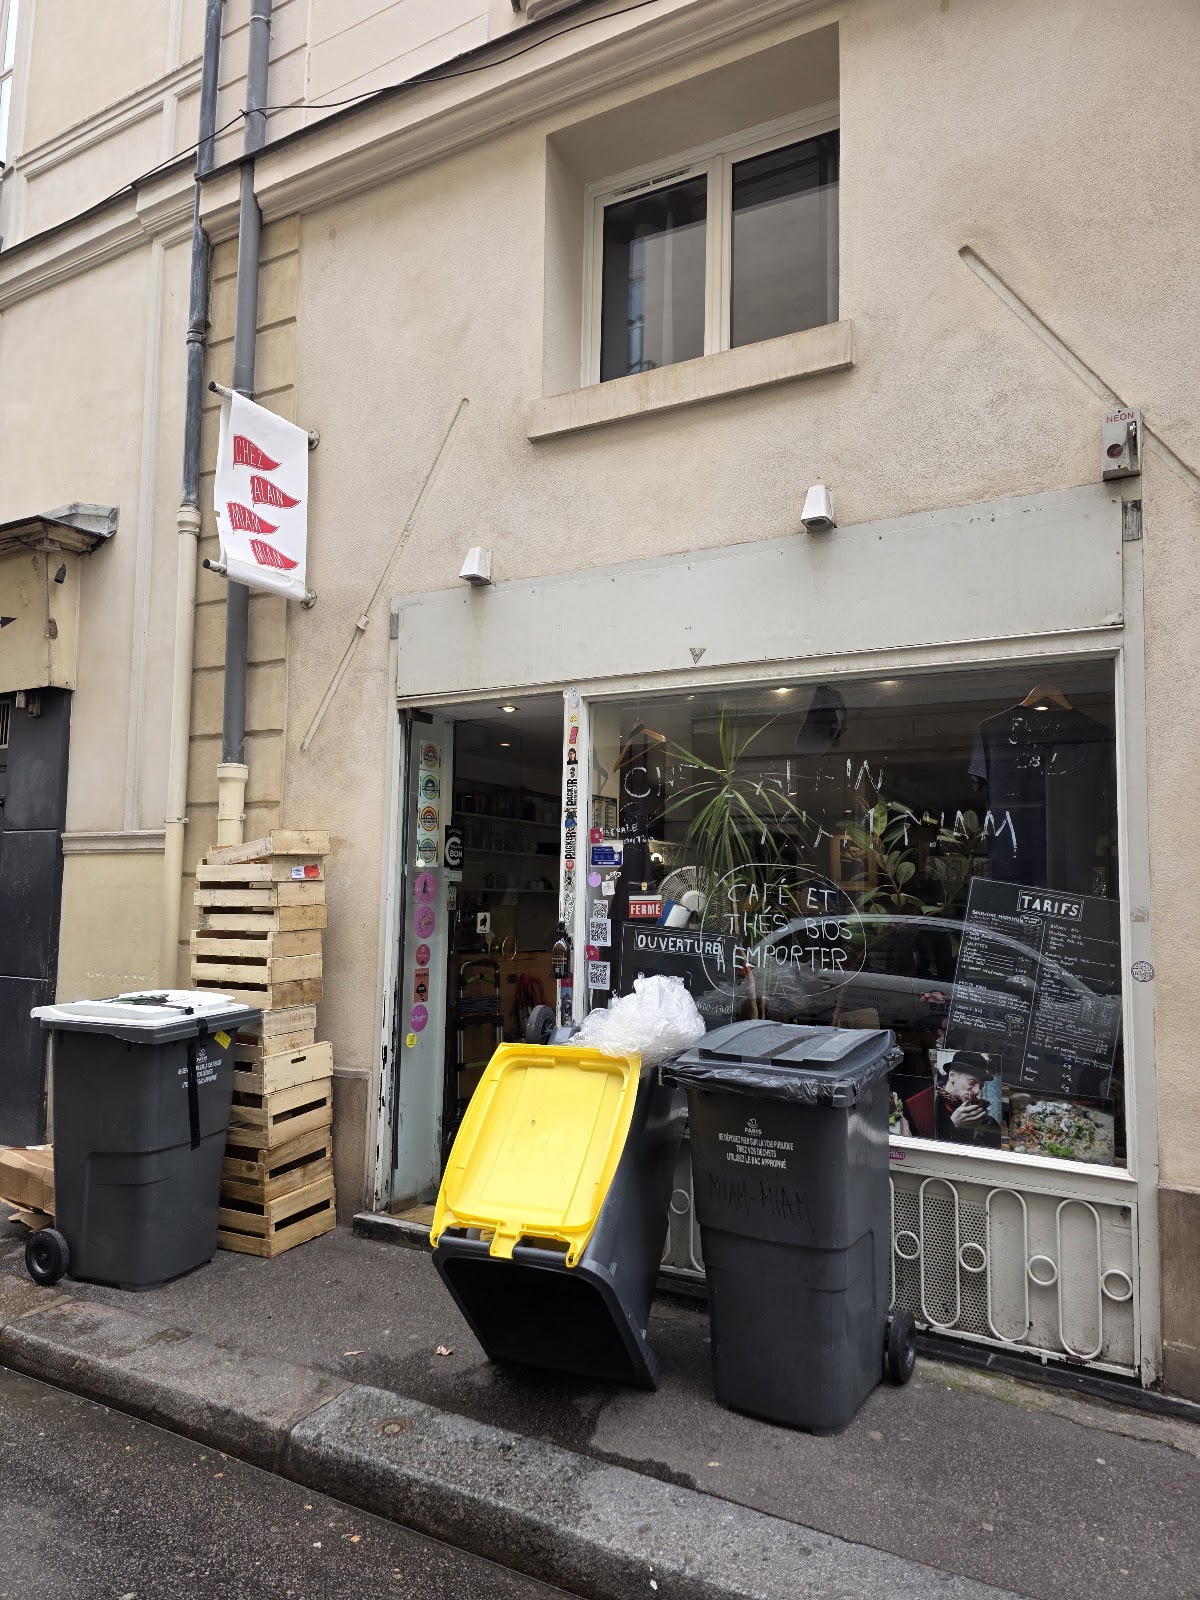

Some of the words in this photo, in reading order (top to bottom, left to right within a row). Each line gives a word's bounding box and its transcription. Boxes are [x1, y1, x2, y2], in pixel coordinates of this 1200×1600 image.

[1106, 412, 1134, 423] NEON
[236, 438, 264, 468] CHEZ
[254, 478, 284, 506] ALAIN
[232, 504, 262, 532] MIAM
[254, 542, 285, 568] MIAM
[565, 830, 576, 859] PACKER
[728, 878, 790, 906] CAFÉ
[806, 888, 836, 912] ET
[1022, 895, 1080, 917] TARIFS
[630, 902, 661, 915] FERMÉ
[724, 906, 788, 938] THÉS
[637, 934, 720, 955] OUVERTURE
[733, 944, 848, 974] EMPORTER
[736, 1145, 748, 1154] TRIEZ
[748, 1147, 756, 1155] VOS
[757, 1147, 776, 1158] DÉCHETS
[750, 1137, 758, 1146] SUR
[774, 1141, 793, 1150] PUBLIQUE
[726, 1152, 745, 1163] UTILISEZ
[745, 1156, 751, 1164] LE
[761, 1158, 786, 1169] APPROPRIÉ
